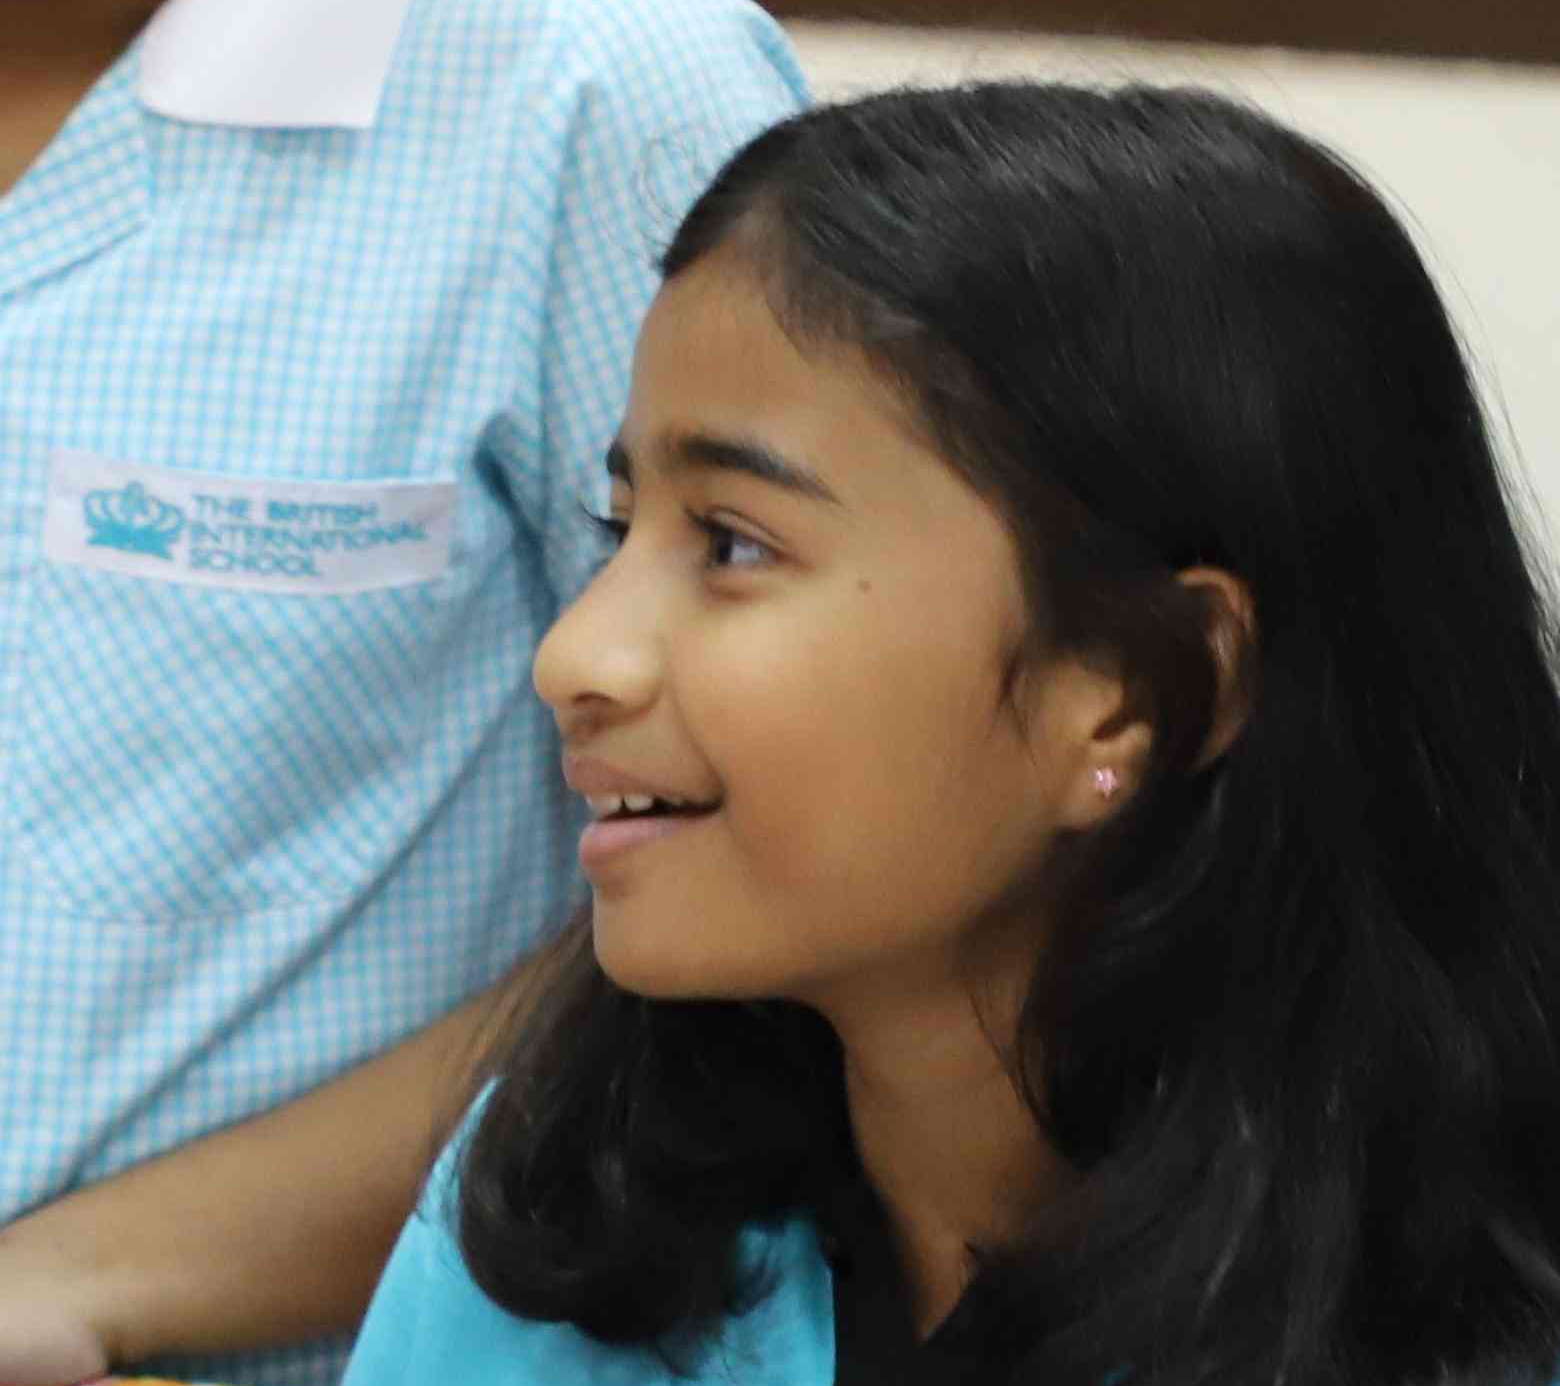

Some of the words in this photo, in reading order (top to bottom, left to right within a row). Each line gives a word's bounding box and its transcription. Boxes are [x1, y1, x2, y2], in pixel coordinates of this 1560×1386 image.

[192, 492, 251, 519] THE
[266, 500, 379, 524] BRITISH
[188, 520, 429, 552] INTERNATIONAL
[189, 550, 320, 576] SCHOOL
